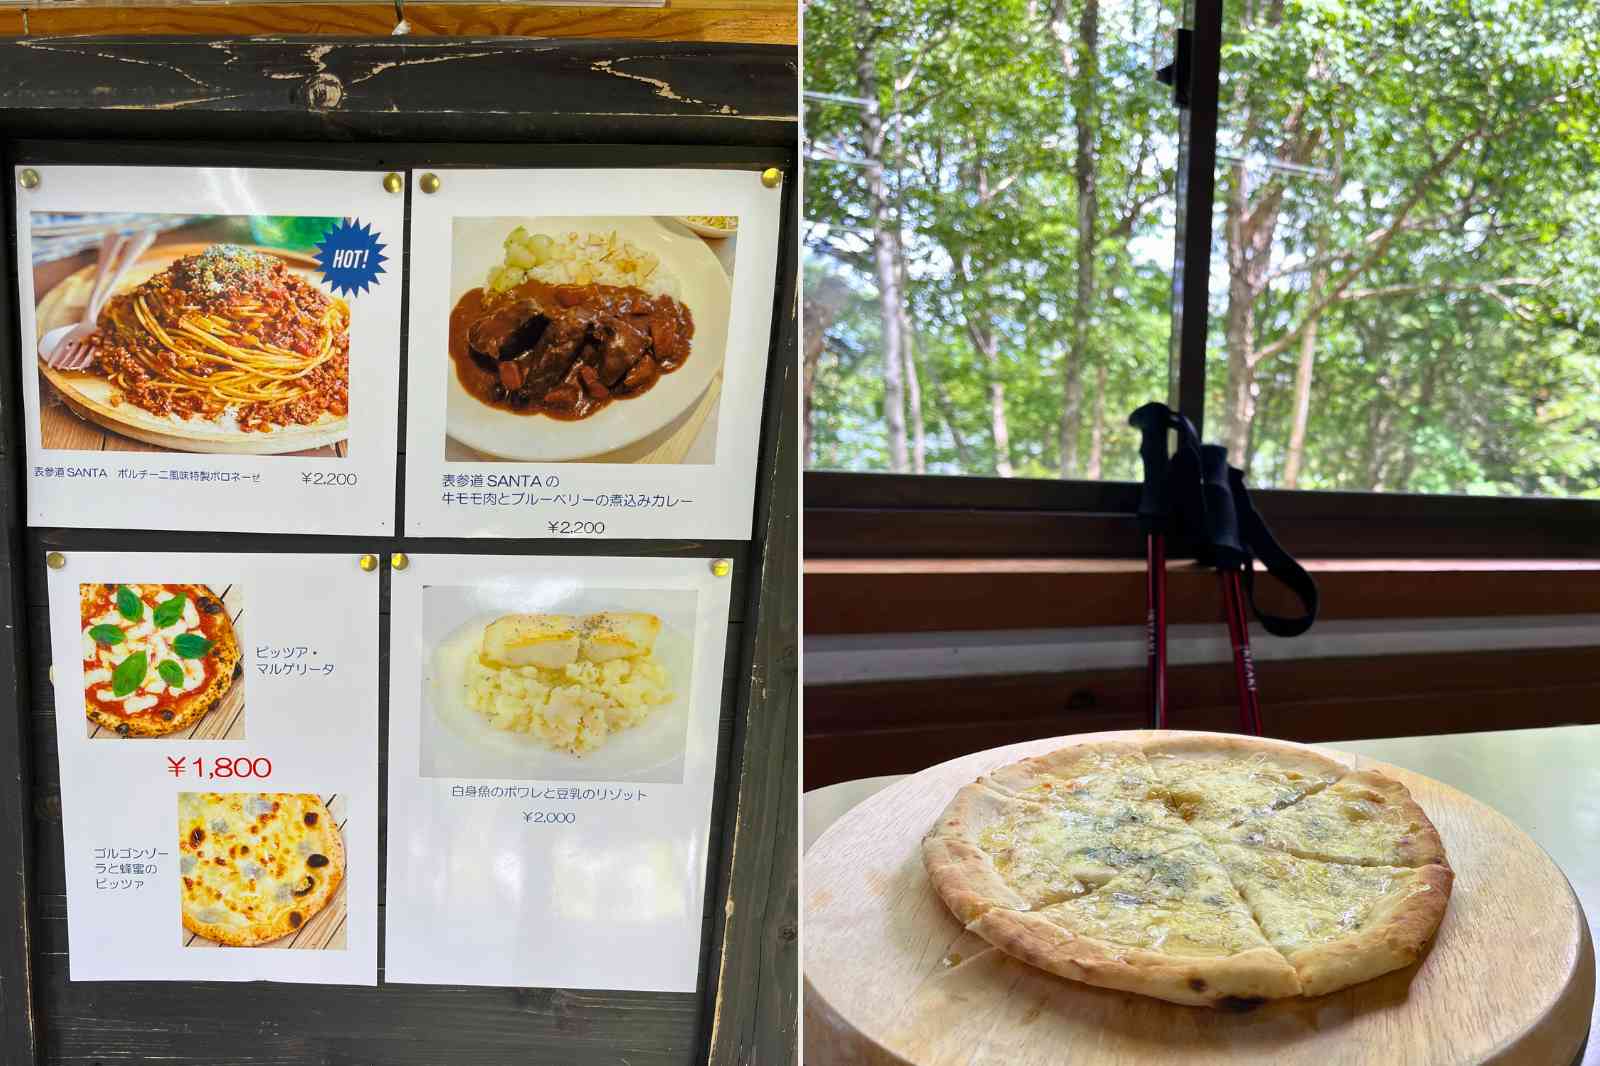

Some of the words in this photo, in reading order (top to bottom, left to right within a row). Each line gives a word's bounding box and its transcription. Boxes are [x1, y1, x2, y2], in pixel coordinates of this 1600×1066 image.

[332, 249, 369, 269] HOT!
[67, 467, 107, 478] SANTA
[487, 475, 542, 488] SANTA
[167, 756, 272, 779] ¥1,800
